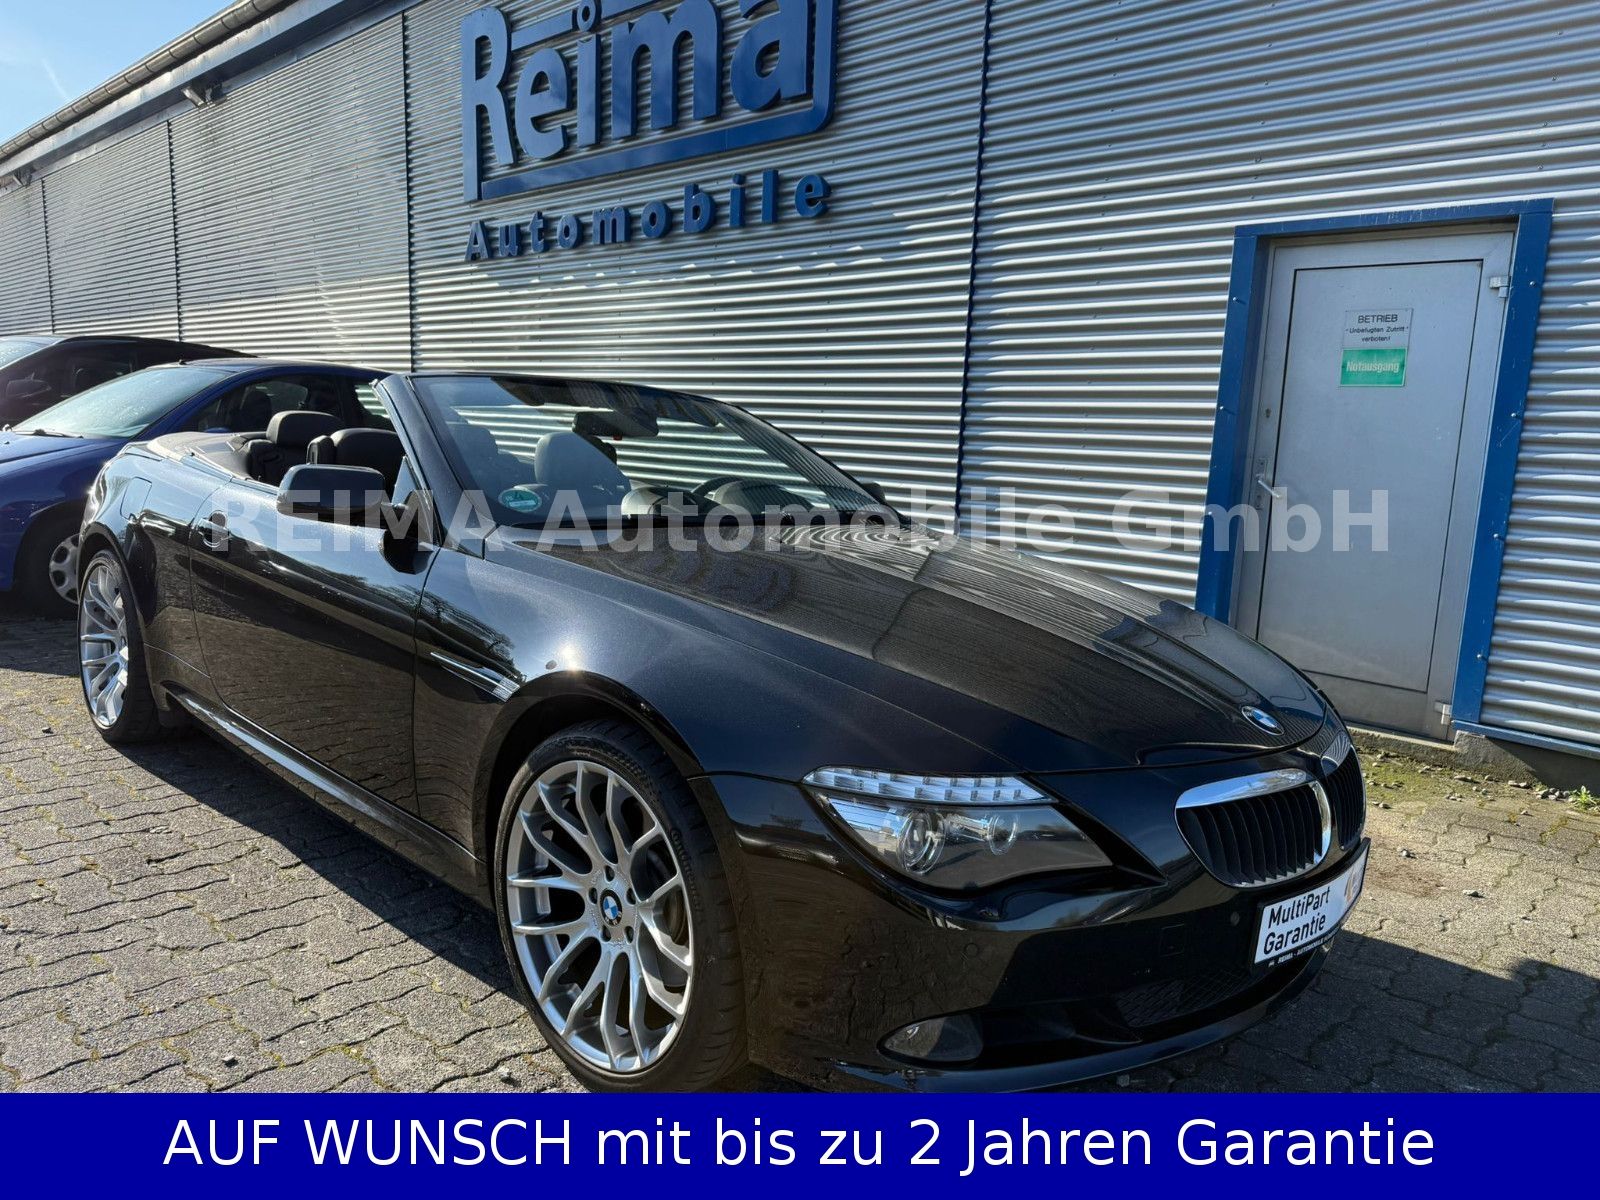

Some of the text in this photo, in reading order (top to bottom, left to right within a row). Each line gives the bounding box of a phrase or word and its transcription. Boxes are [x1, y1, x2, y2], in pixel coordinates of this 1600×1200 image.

[461, 0, 815, 200] Reima
[464, 168, 832, 262] Automobile
[1357, 313, 1398, 324] BETRIEB
[1346, 361, 1400, 373] Notausgang
[1268, 886, 1330, 929] MultiPart
[1263, 912, 1326, 955] Garantie
